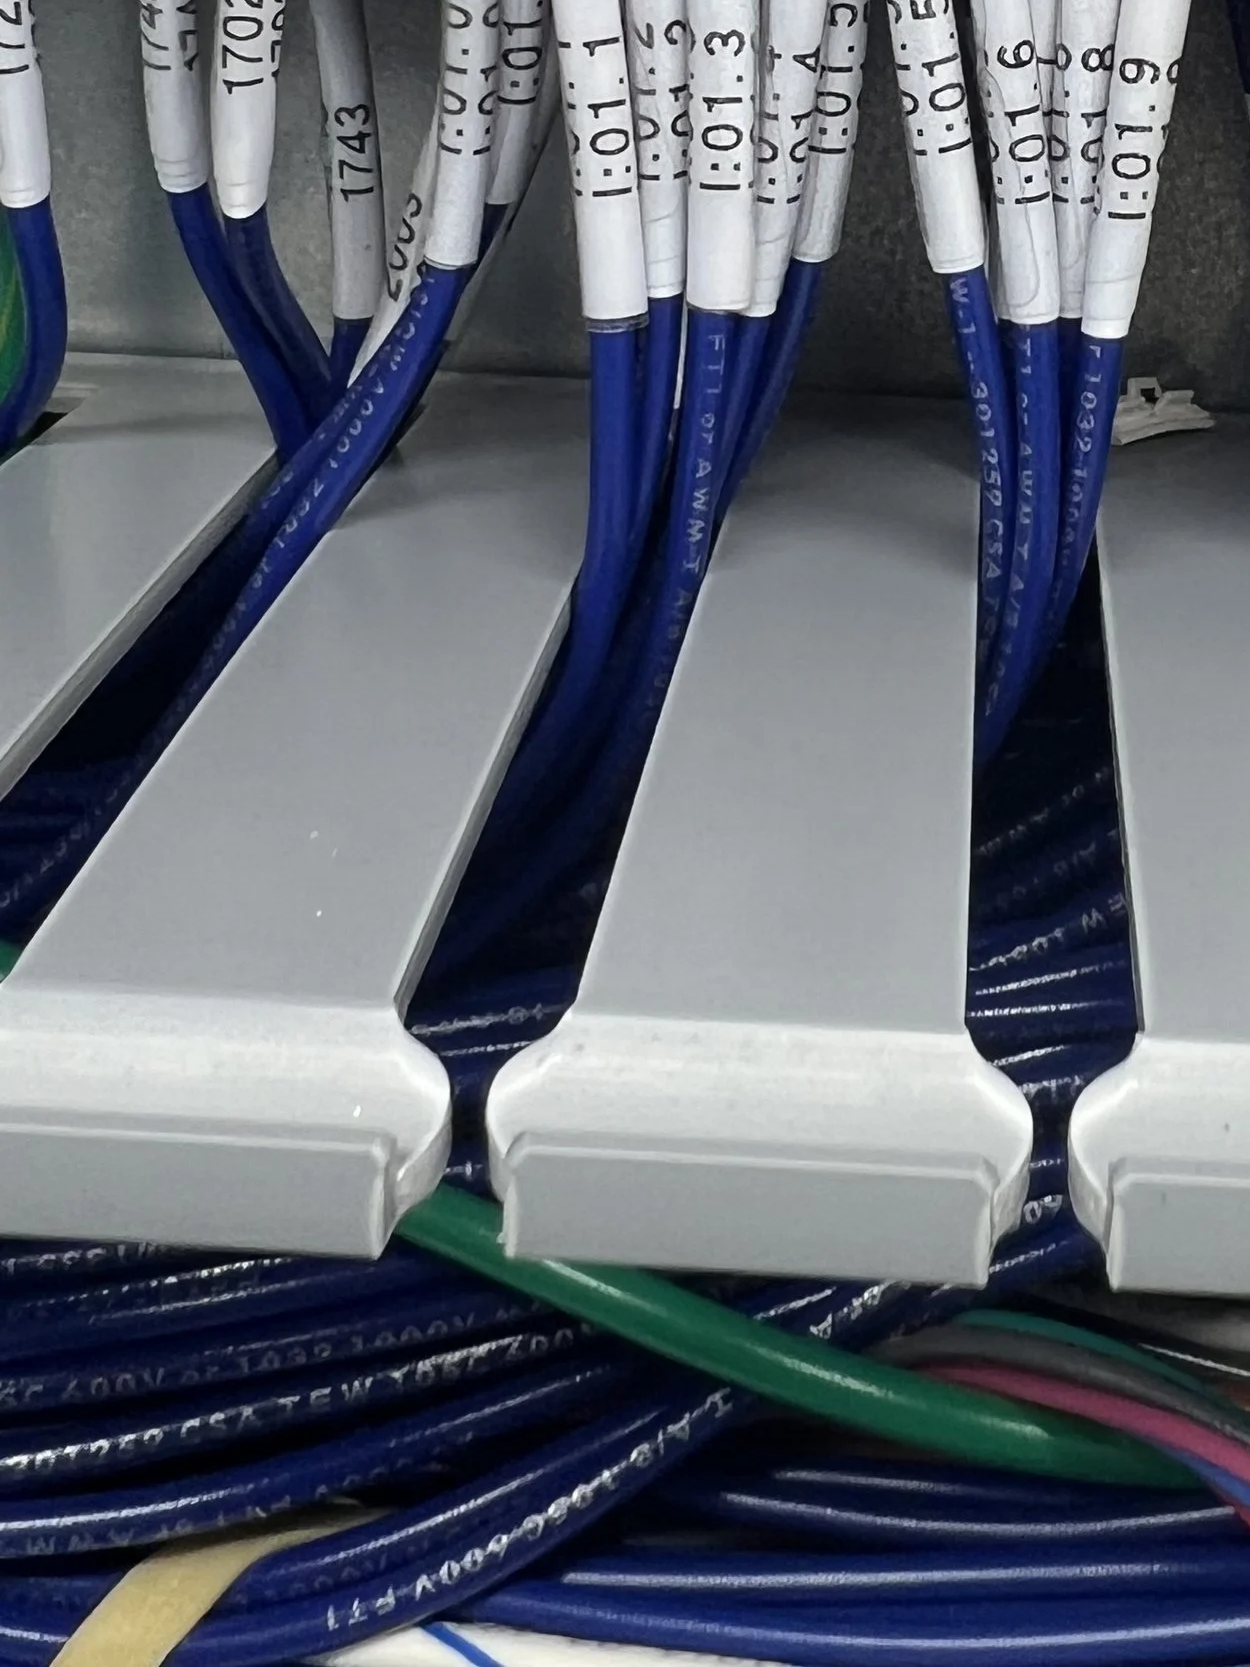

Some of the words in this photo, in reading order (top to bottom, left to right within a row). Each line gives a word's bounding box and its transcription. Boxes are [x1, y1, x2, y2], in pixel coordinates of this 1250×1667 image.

[333, 103, 374, 202] 1743
[582, 36, 633, 197] I:01.1
[699, 29, 746, 191] I:01.3
[997, 39, 1051, 205] I:01.6
[1107, 56, 1161, 219] I:01.9
